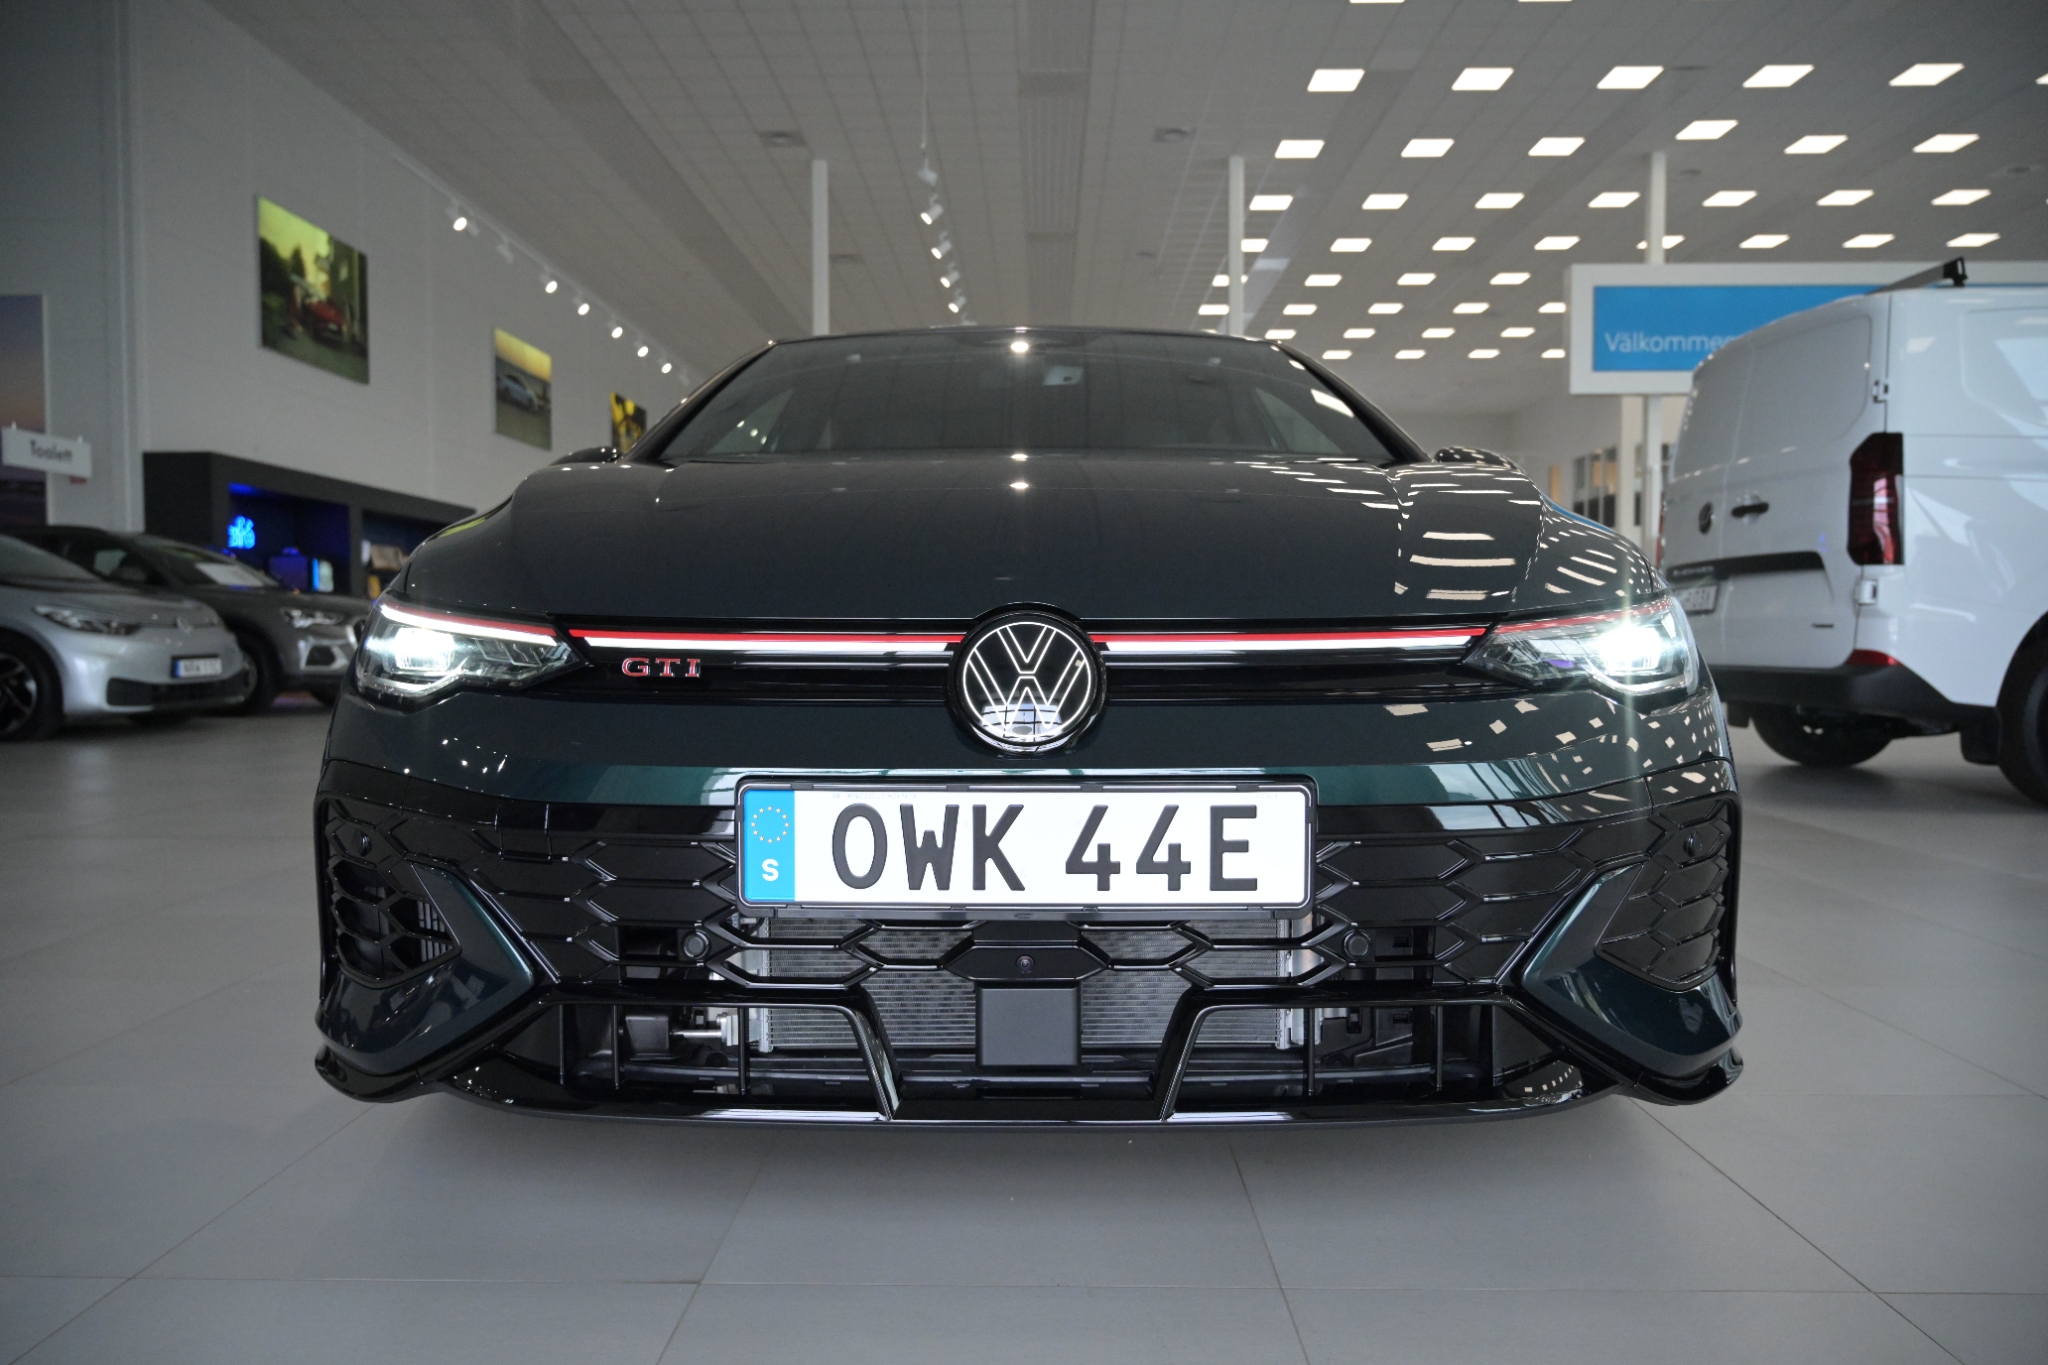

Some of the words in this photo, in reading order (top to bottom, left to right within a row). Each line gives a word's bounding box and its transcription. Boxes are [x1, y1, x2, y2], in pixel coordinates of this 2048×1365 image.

[228, 516, 256, 549] afé
[621, 657, 701, 678] GTI
[832, 803, 1025, 891] OWK
[1065, 804, 1258, 891] 44E
[761, 858, 779, 881] S
